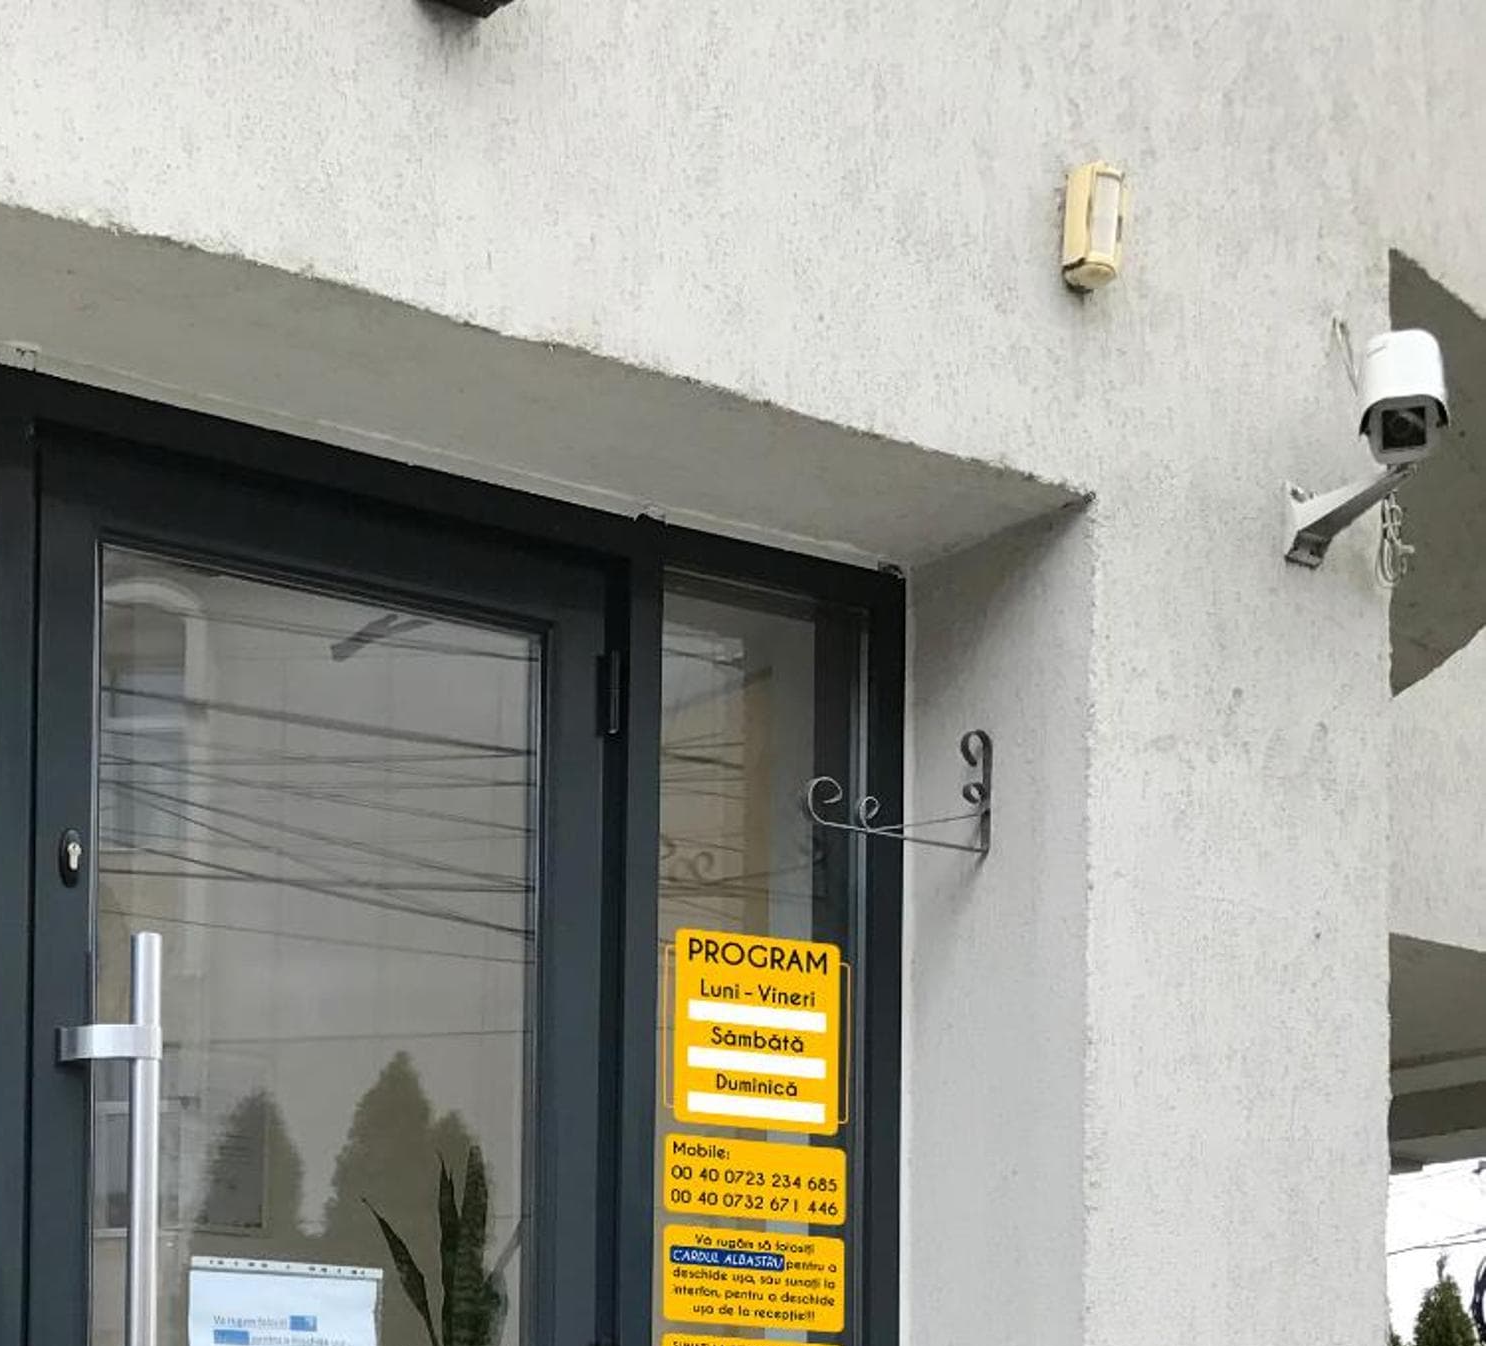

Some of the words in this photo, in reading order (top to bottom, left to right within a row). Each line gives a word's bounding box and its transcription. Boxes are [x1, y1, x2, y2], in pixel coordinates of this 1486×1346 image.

[688, 937, 828, 976] PROGRAM
[700, 978, 740, 1000] Luni
[758, 984, 816, 1008] Vineri
[716, 1073, 797, 1097] Duminică
[673, 1141, 730, 1160] Mobile:
[671, 1165, 692, 1180] 00
[699, 1168, 720, 1182] 40
[724, 1170, 765, 1186] 0723
[772, 1174, 801, 1189] 234
[808, 1177, 837, 1192] 685
[670, 1188, 692, 1204] 00
[698, 1192, 718, 1205] 40
[722, 1193, 764, 1210] 0732
[770, 1197, 798, 1213] 671
[808, 1200, 838, 1216] 446
[672, 1249, 720, 1264] CARDUL
[723, 1252, 784, 1270] ALBASTRU
[786, 1260, 825, 1273] pentru
[828, 1264, 837, 1273] a
[673, 1266, 728, 1281] deschide
[760, 1275, 782, 1285] sau
[824, 1277, 835, 1289] la
[725, 1289, 764, 1301] pentru
[768, 1293, 777, 1302] a
[780, 1291, 835, 1306] deschide
[718, 1304, 733, 1316] de
[738, 1305, 750, 1317] la
